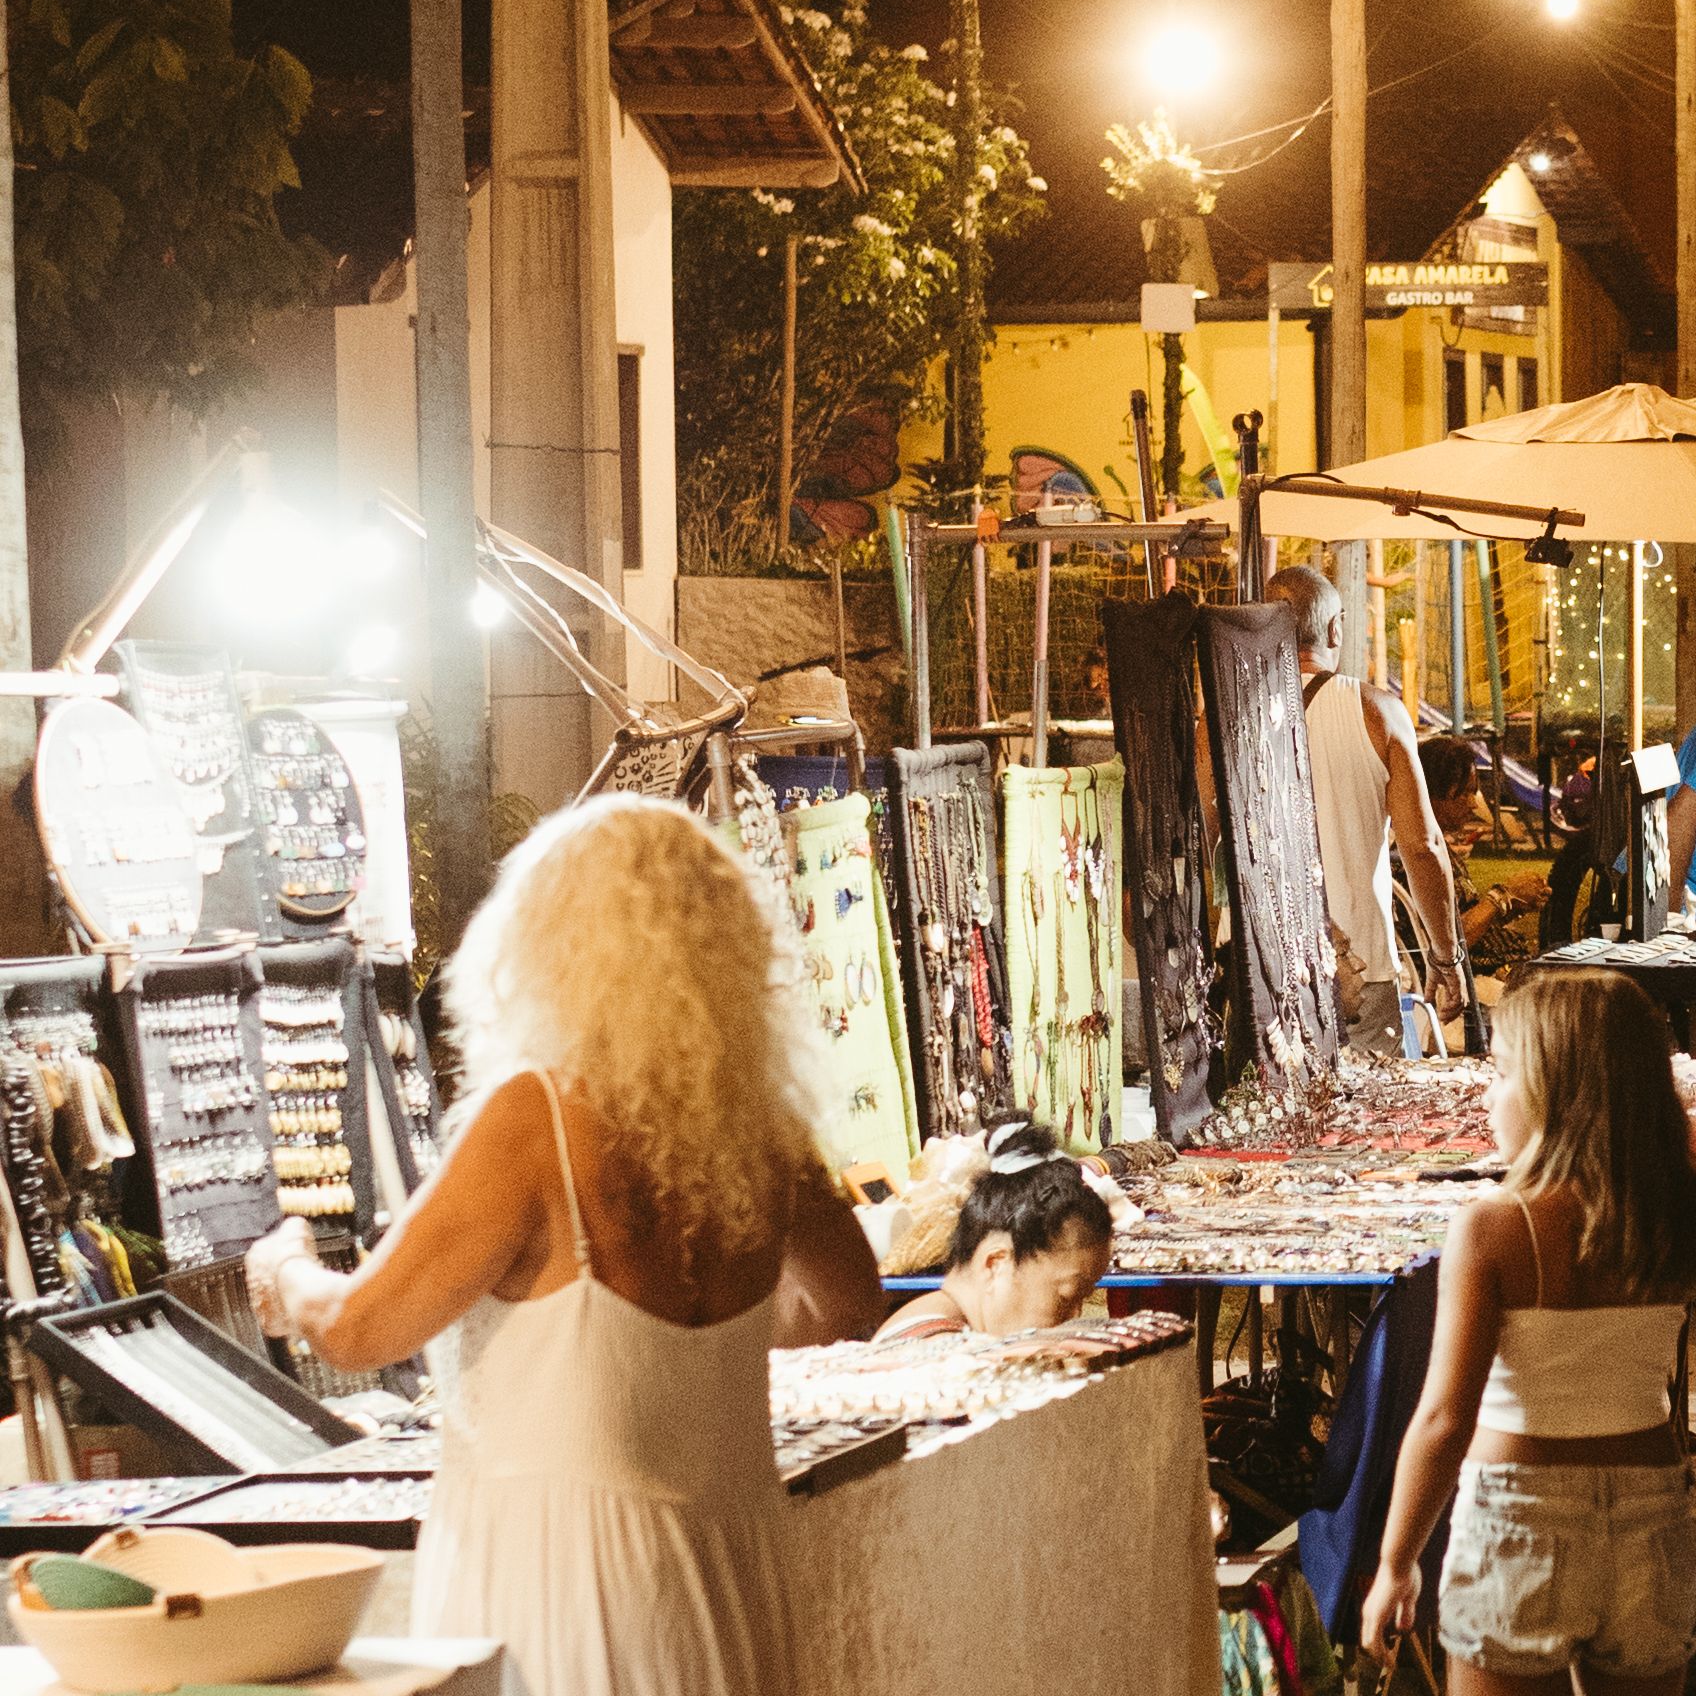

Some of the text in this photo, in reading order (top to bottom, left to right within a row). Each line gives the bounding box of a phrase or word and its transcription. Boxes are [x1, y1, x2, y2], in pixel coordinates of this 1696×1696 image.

[1414, 265, 1509, 285] AMARELA
[1385, 291, 1474, 306] GASTRO BAR
